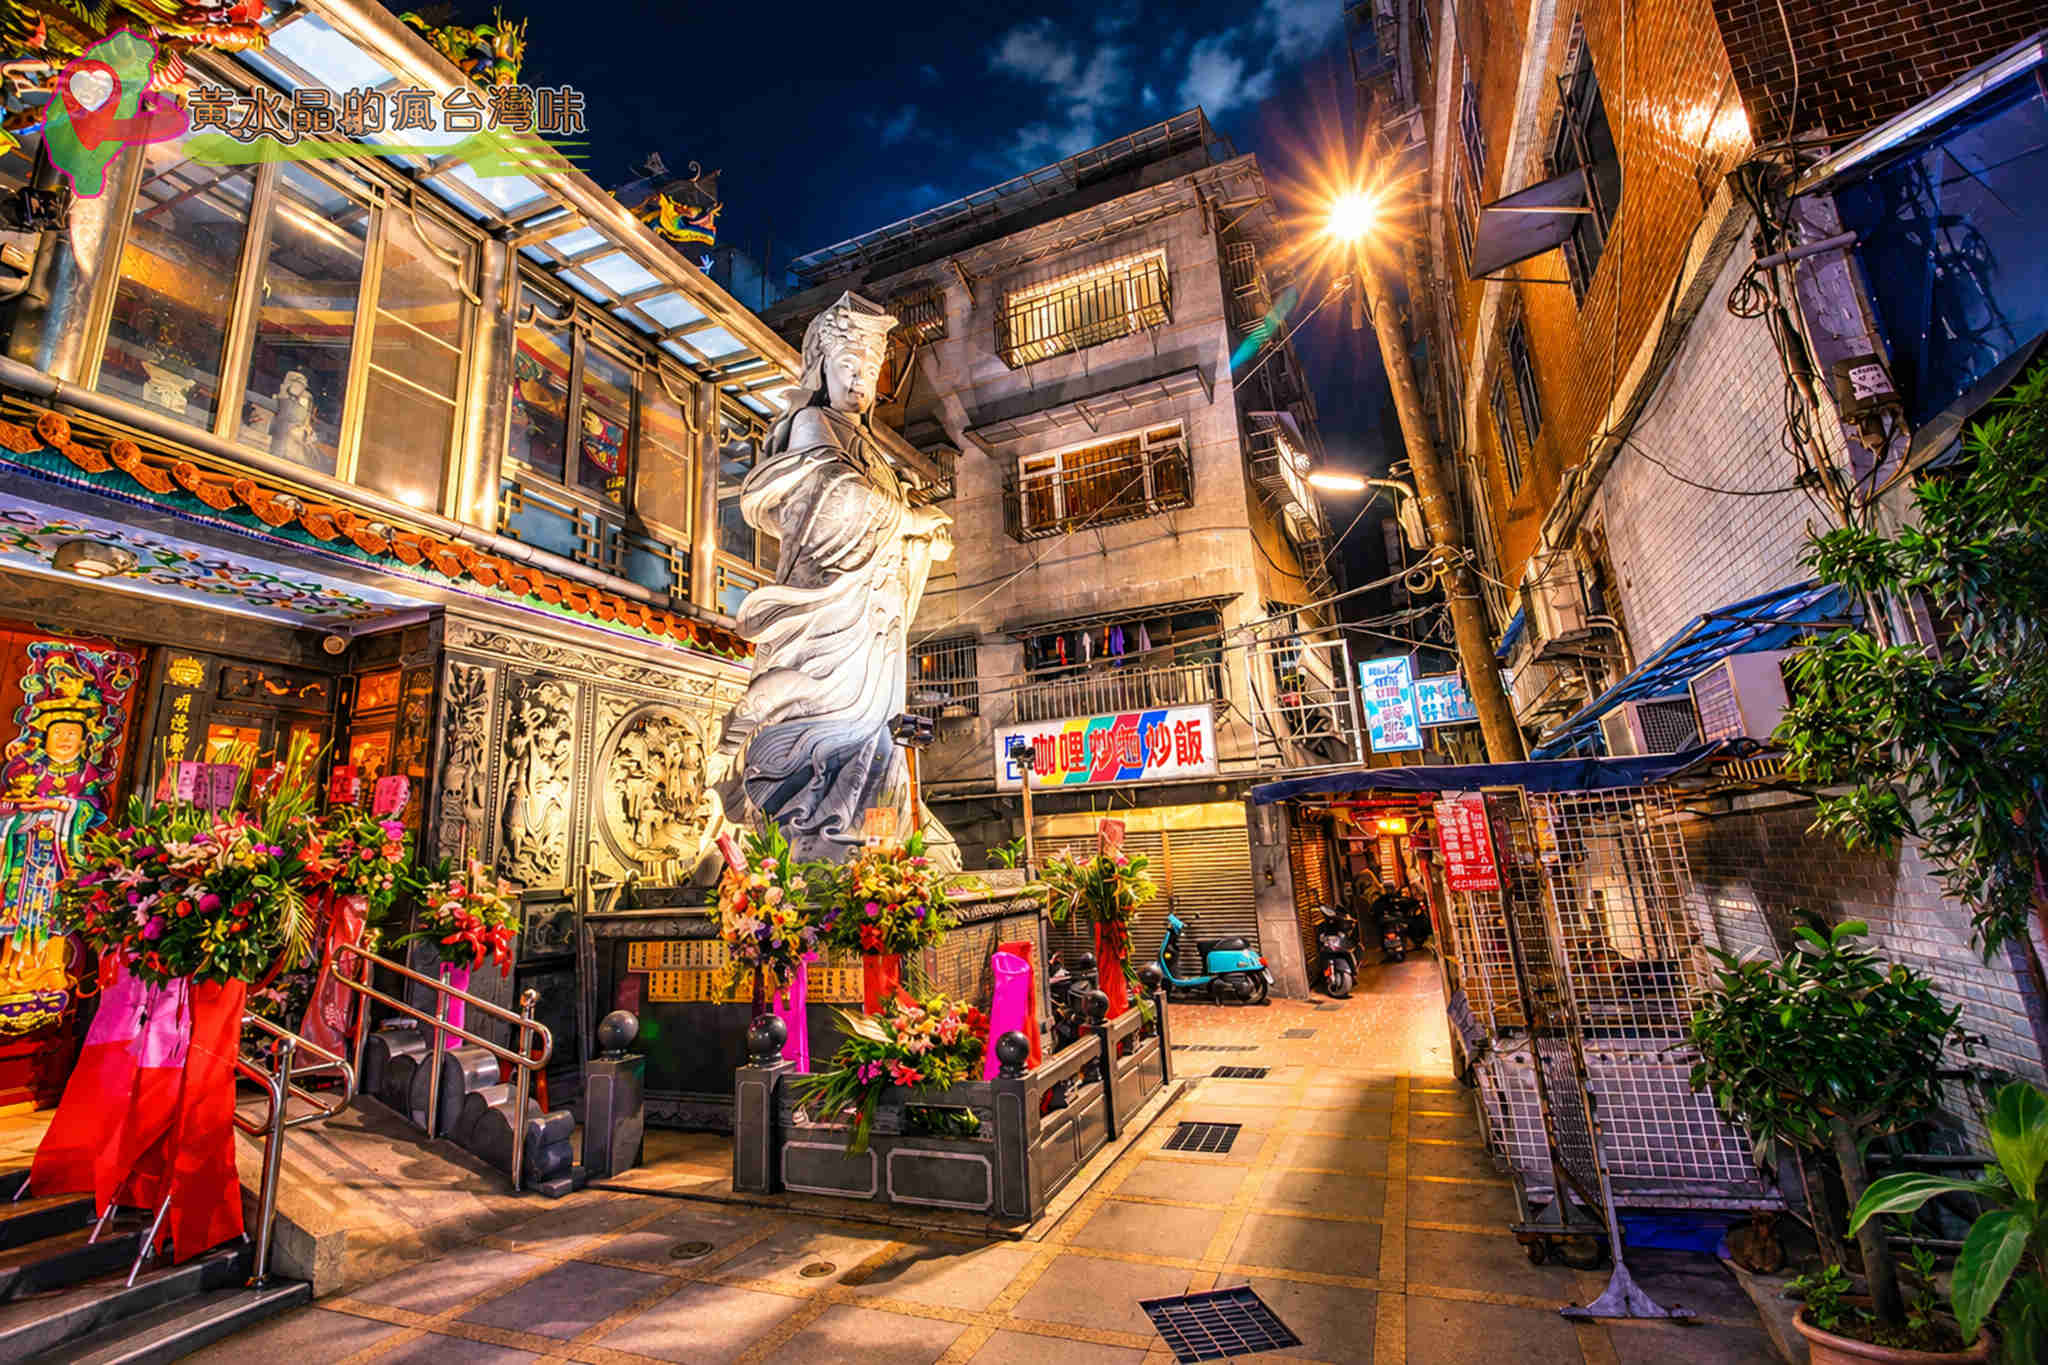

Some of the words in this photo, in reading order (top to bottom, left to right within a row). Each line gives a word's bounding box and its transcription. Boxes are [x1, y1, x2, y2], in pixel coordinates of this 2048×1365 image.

[1032, 719, 1204, 776] 咖哩炒麵炒飯
